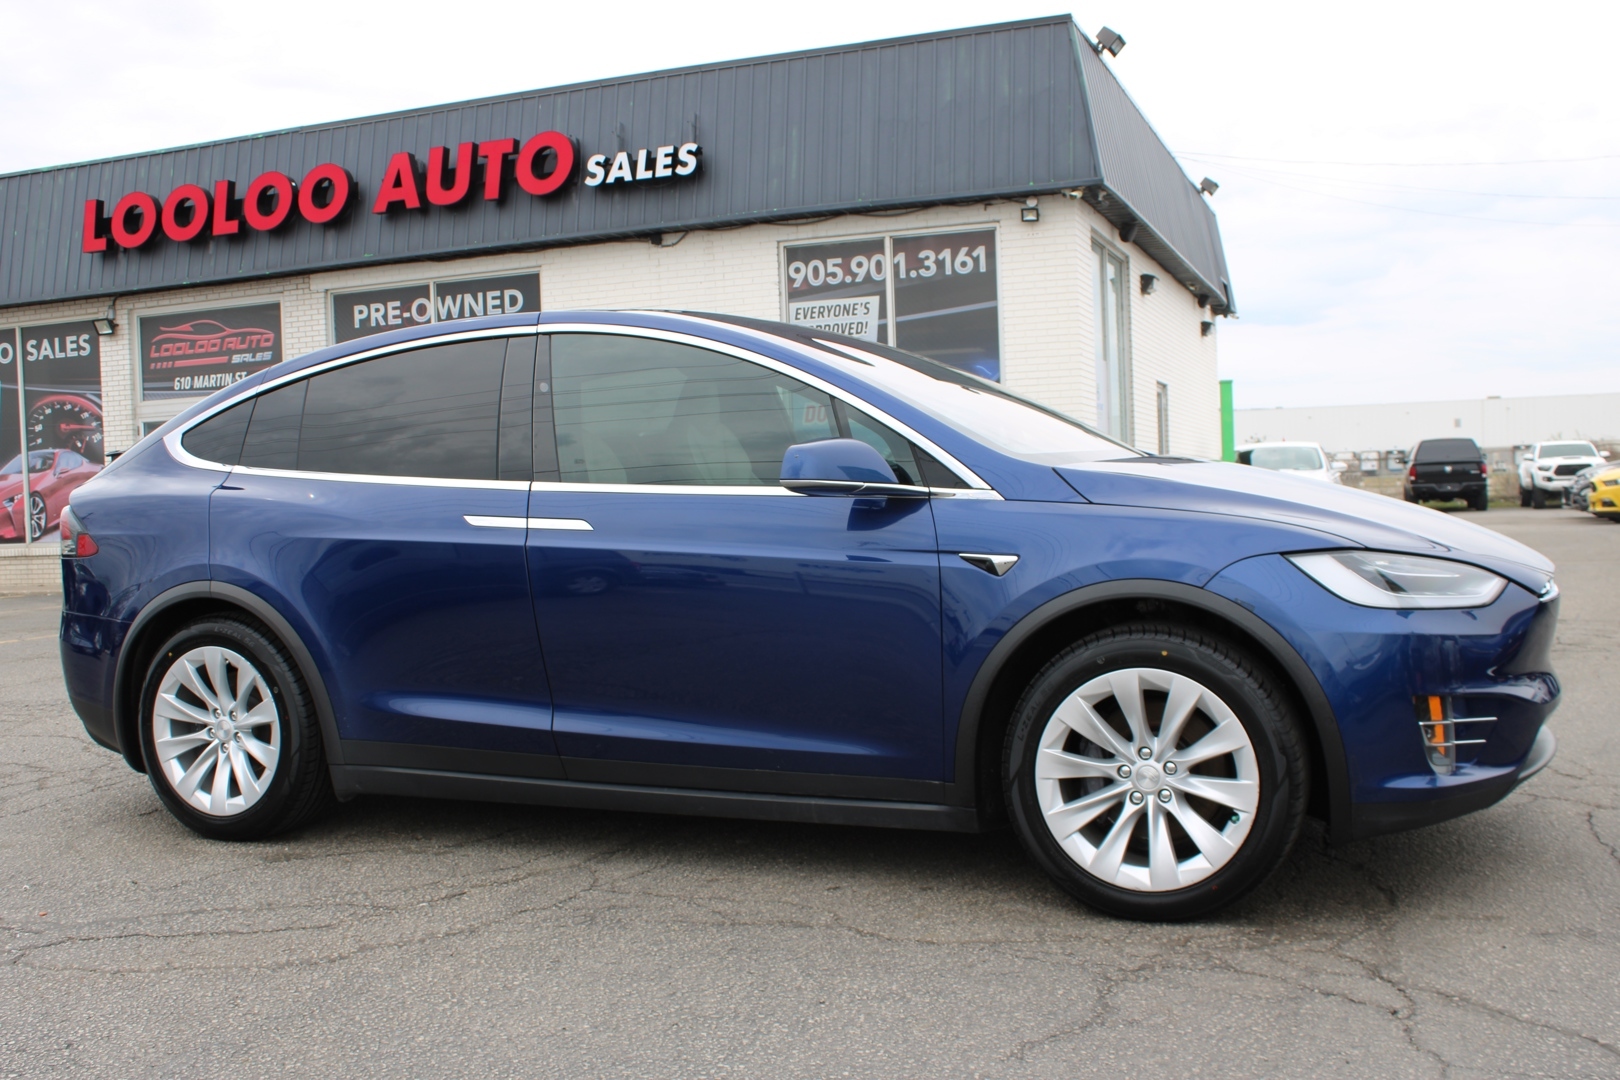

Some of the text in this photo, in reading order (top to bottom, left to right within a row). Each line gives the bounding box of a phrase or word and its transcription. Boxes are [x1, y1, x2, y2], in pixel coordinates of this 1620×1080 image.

[82, 131, 699, 253] LOOLOO AUTO SALES
[788, 245, 987, 288] 905.901.3161
[353, 289, 524, 329] PRE-OWNED
[795, 302, 870, 320] EVERYONE'S
[26, 334, 91, 361] SALES
[150, 333, 275, 358] LOOLOO AUTO
[231, 351, 273, 364] SALES
[174, 377, 191, 390] 610
[193, 372, 233, 389] MARTIN
